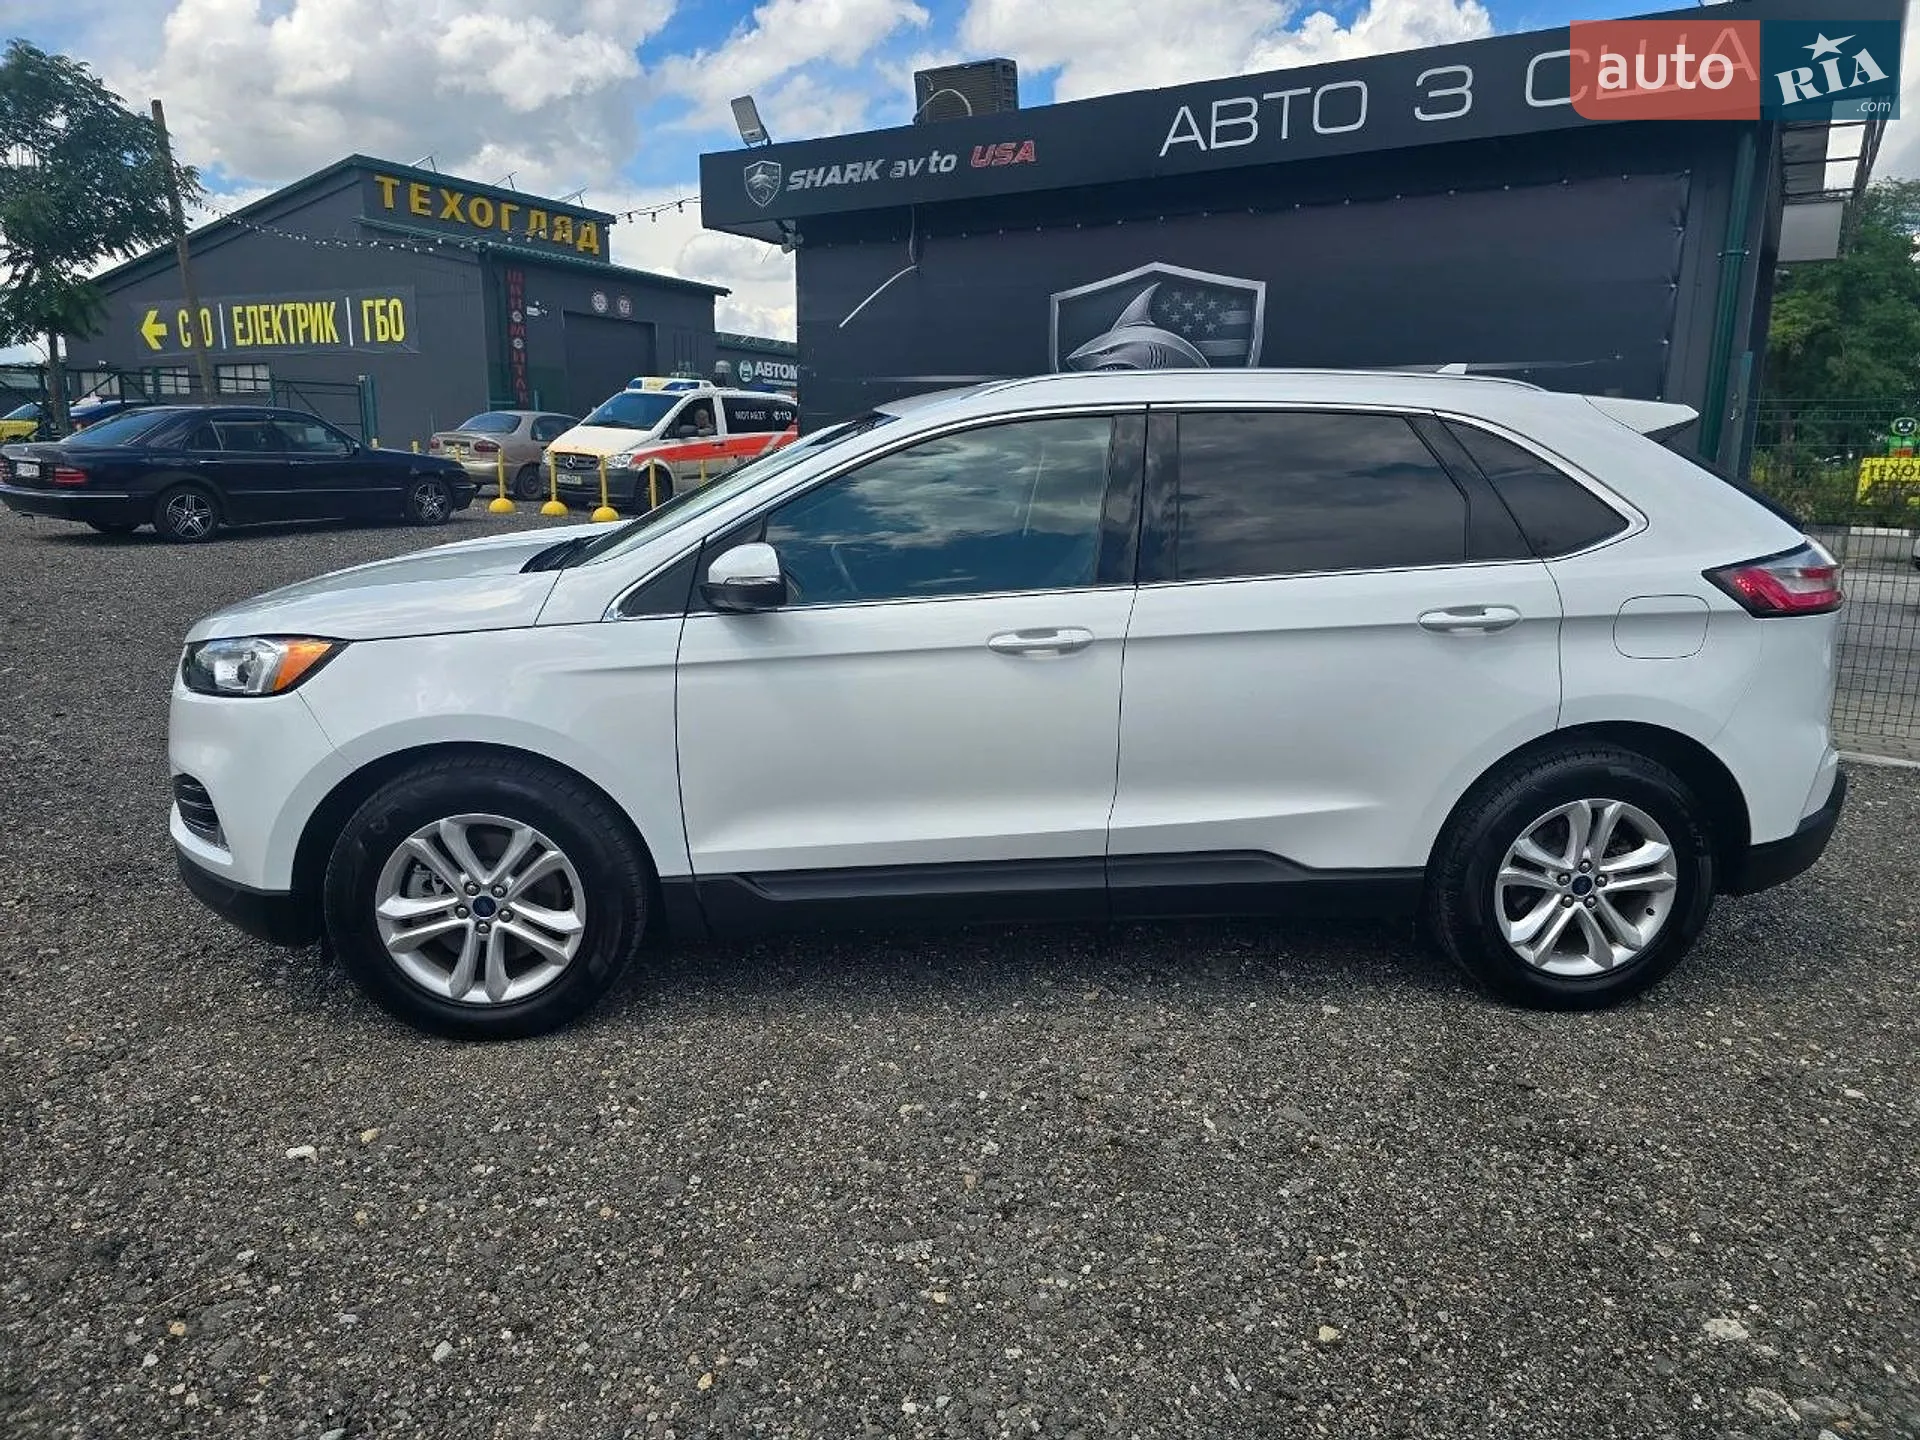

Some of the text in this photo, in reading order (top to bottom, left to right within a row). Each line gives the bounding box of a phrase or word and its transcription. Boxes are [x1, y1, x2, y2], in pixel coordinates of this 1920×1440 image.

[1159, 80, 1368, 157] АВТО
[1524, 27, 1758, 108] США
[786, 159, 886, 191] SHARK
[970, 139, 1037, 168] USA
[374, 175, 600, 255] ТЕХОГЛЯД
[178, 298, 405, 348] СО ЕЛЕКТРИК ГБО
